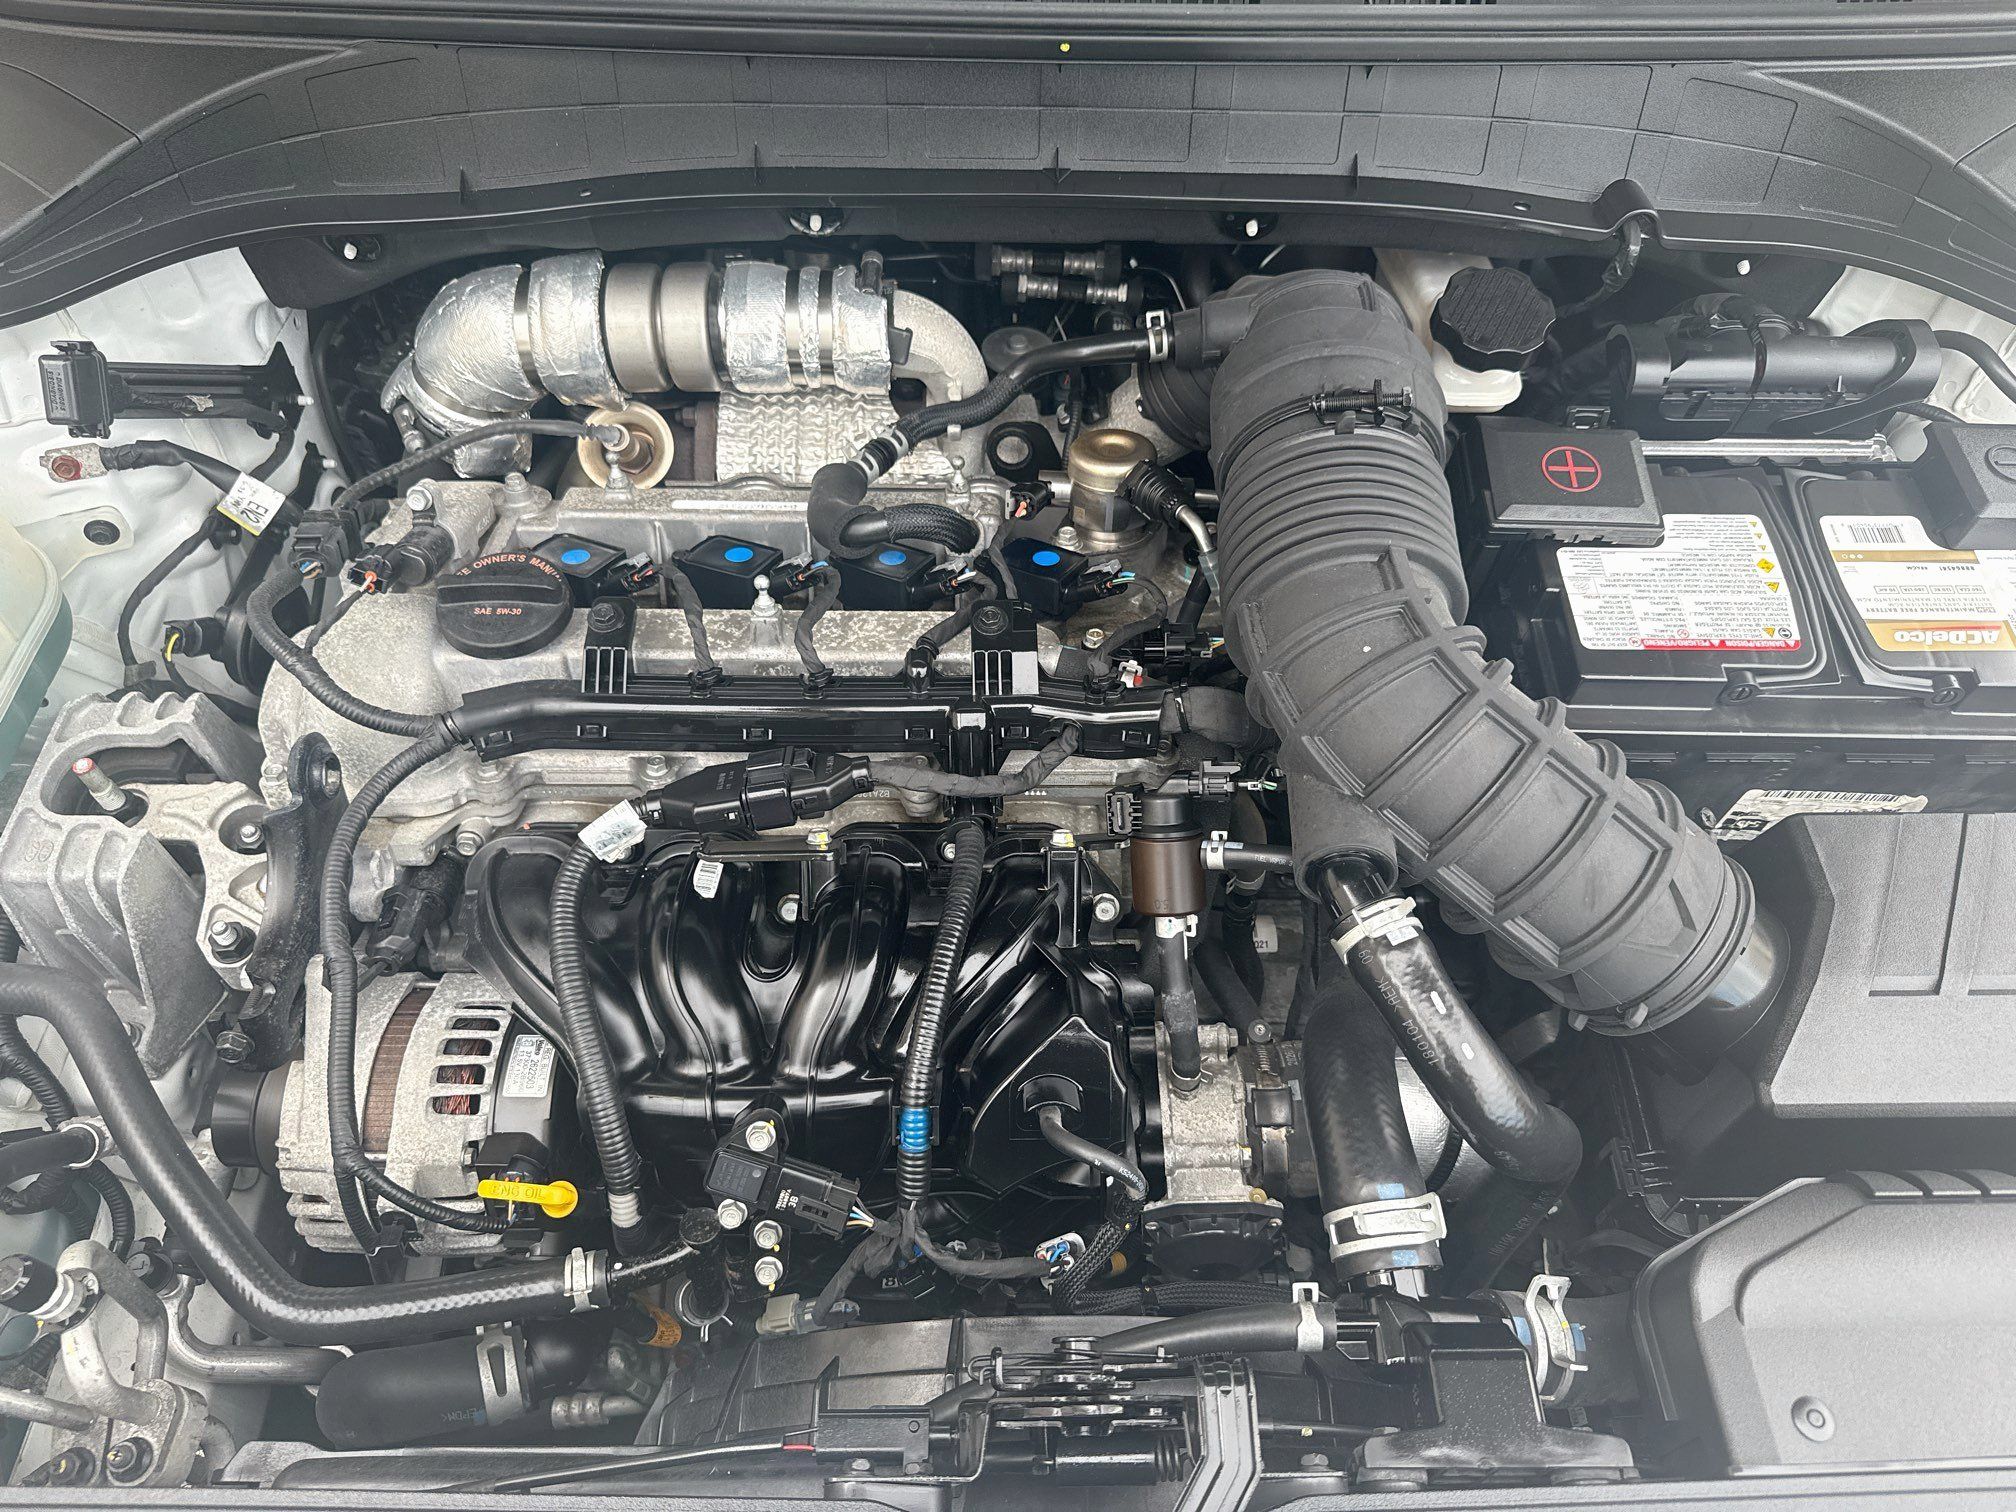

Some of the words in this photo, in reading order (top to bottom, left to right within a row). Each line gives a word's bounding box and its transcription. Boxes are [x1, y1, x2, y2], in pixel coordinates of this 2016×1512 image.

[473, 553, 527, 569] OWNER'S
[474, 607, 492, 615] SAE
[496, 607, 522, 616] 5W-30
[1725, 640, 1786, 648] DANGER/POISON
[1893, 630, 2000, 646] ACDelco
[534, 1039, 545, 1056] Valeo
[1401, 1018, 1440, 1066] 180104
[525, 1059, 540, 1090] 2622503
[491, 1184, 520, 1197] ENG
[525, 1187, 545, 1200] OIL
[788, 1195, 799, 1208] 3B
